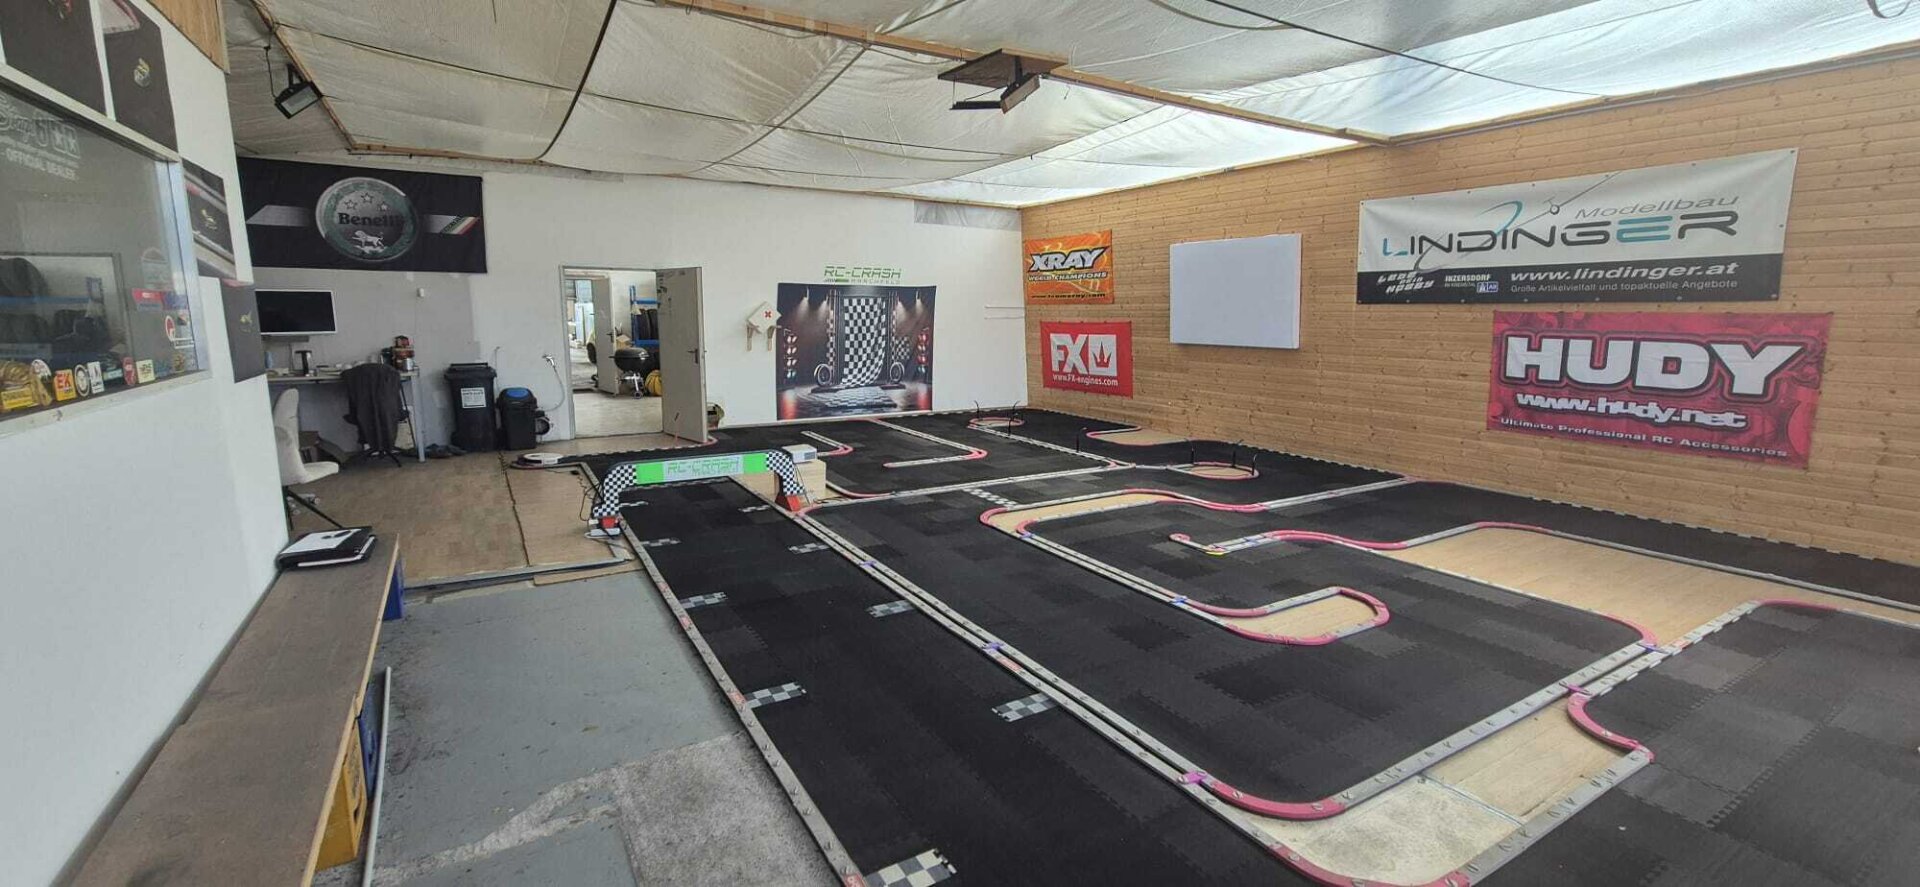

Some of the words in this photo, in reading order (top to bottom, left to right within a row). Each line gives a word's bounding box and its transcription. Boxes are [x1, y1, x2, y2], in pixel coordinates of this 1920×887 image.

[1575, 196, 1739, 220] Modellbau
[1382, 210, 1739, 257] LINDINGER
[1030, 248, 1105, 271] XRAY
[1054, 271, 1108, 281] CHAMPIONS
[1511, 262, 1739, 281] www.lindinger.at
[1511, 284, 1535, 293] Große
[1599, 282, 1619, 291] und
[1621, 280, 1678, 291] topaktuelle
[1682, 279, 1738, 291] Angebote
[1505, 336, 1802, 395] HUDY
[1053, 374, 1118, 387] www.FX-engines.com
[1517, 393, 1747, 428] www.hudy.net
[1501, 418, 1553, 430] Ultimate
[1558, 424, 1647, 441] Professional
[1652, 435, 1673, 444] RC
[1680, 438, 1787, 457] Accessories
